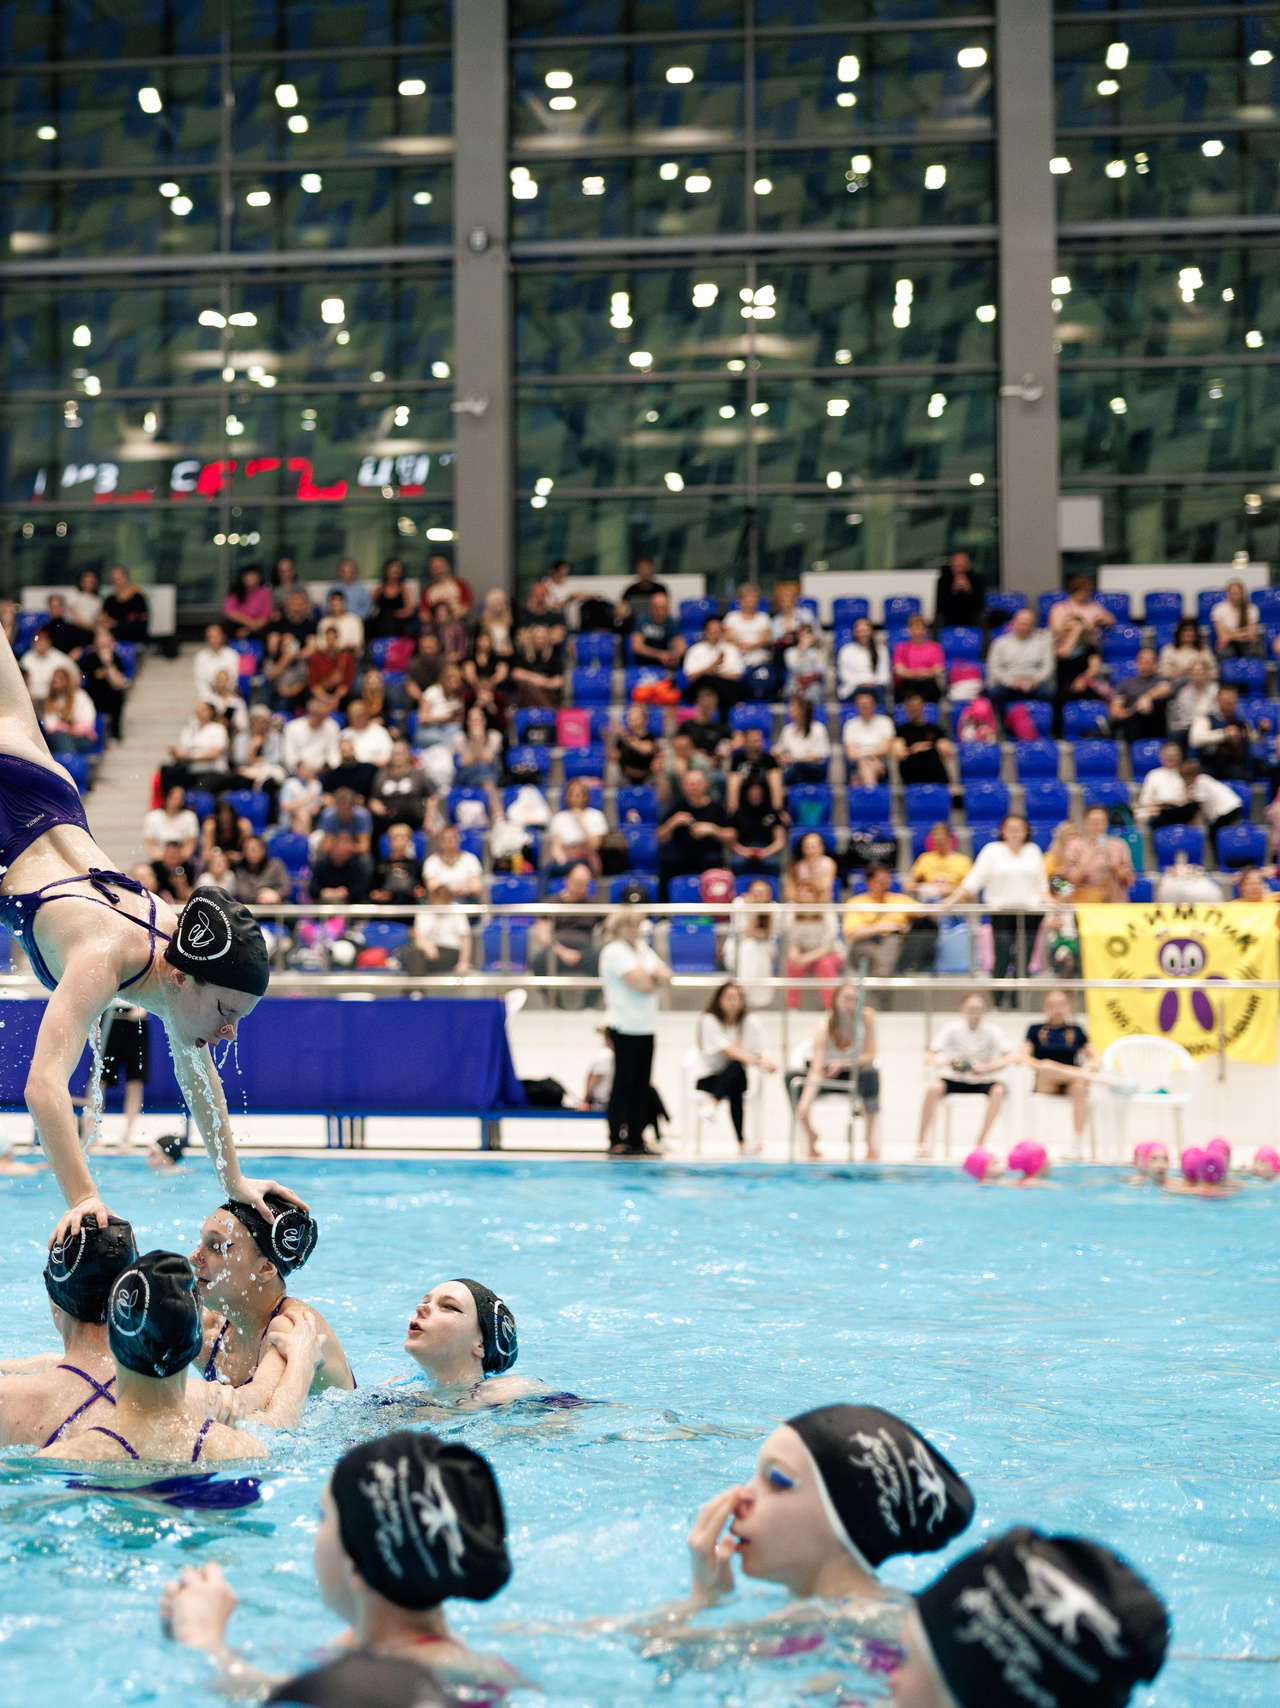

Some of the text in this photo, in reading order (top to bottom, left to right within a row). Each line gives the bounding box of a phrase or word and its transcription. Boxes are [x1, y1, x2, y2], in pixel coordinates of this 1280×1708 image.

[219, 910, 232, 940] ПЛАВАНИЯ
[183, 952, 208, 961] МОСКВА
[282, 1208, 297, 1217] ЛИГА
[271, 1238, 283, 1260] МОСКВА
